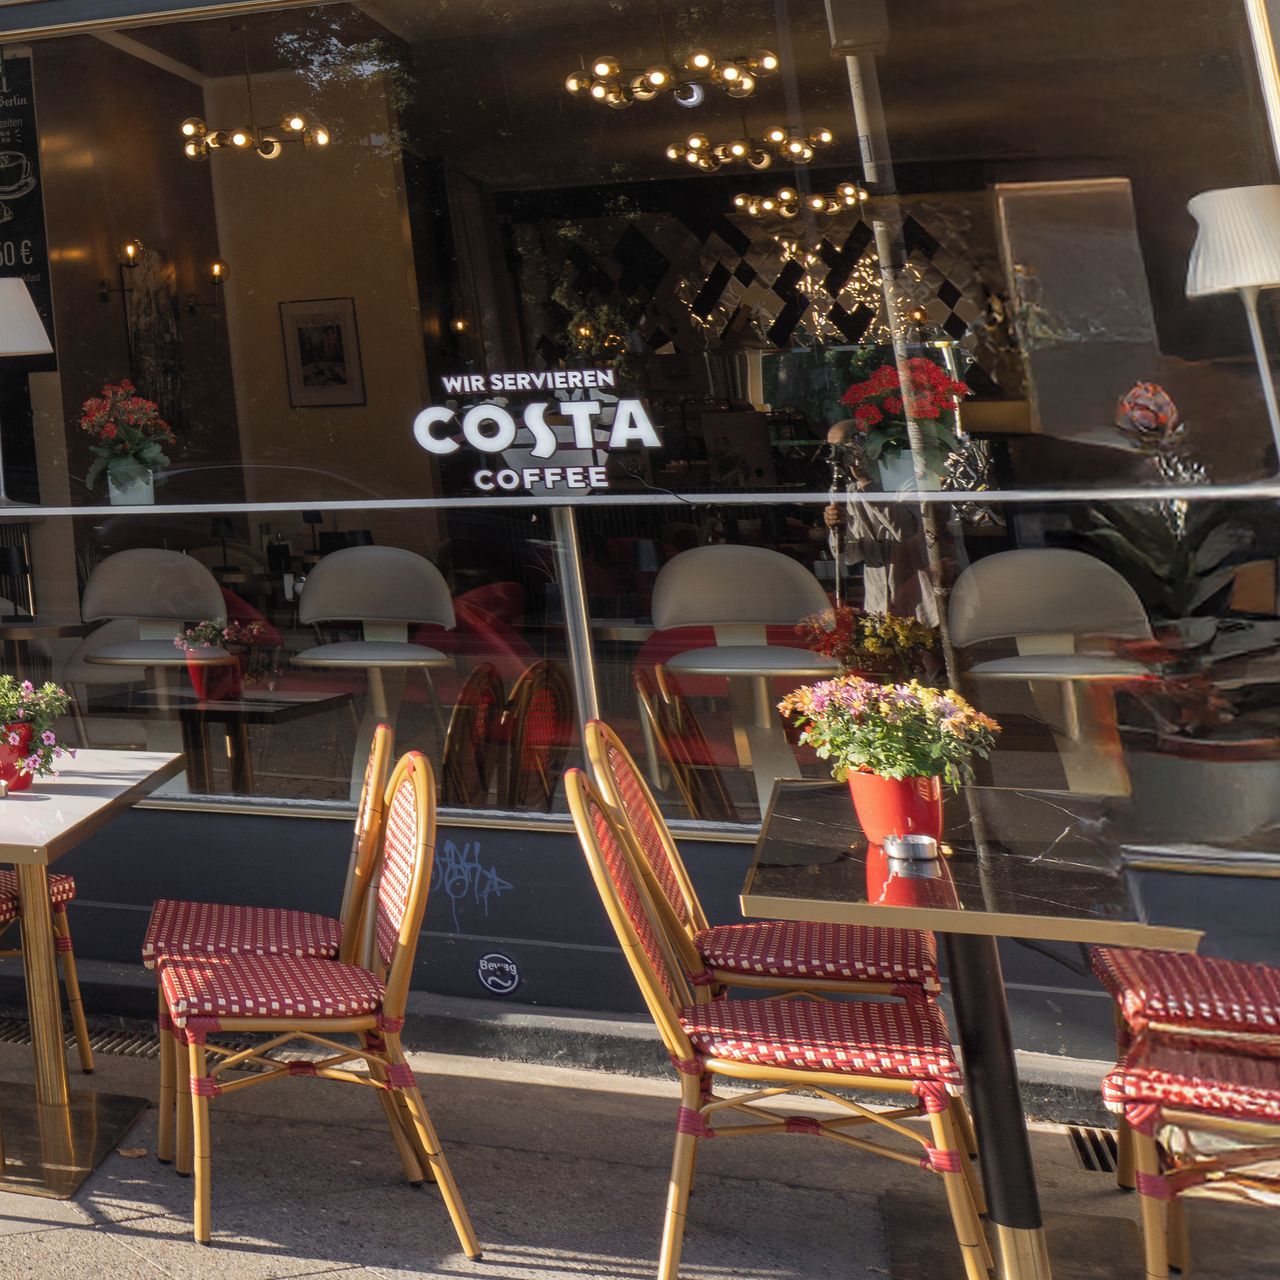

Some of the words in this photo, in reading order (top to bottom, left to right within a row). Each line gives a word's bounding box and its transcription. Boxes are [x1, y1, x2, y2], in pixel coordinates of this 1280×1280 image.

[20, 239, 33, 265] €
[442, 373, 486, 394] WIR
[489, 368, 616, 392] SERVIEREN
[413, 398, 662, 459] COSTA
[473, 466, 609, 491] COFFEE
